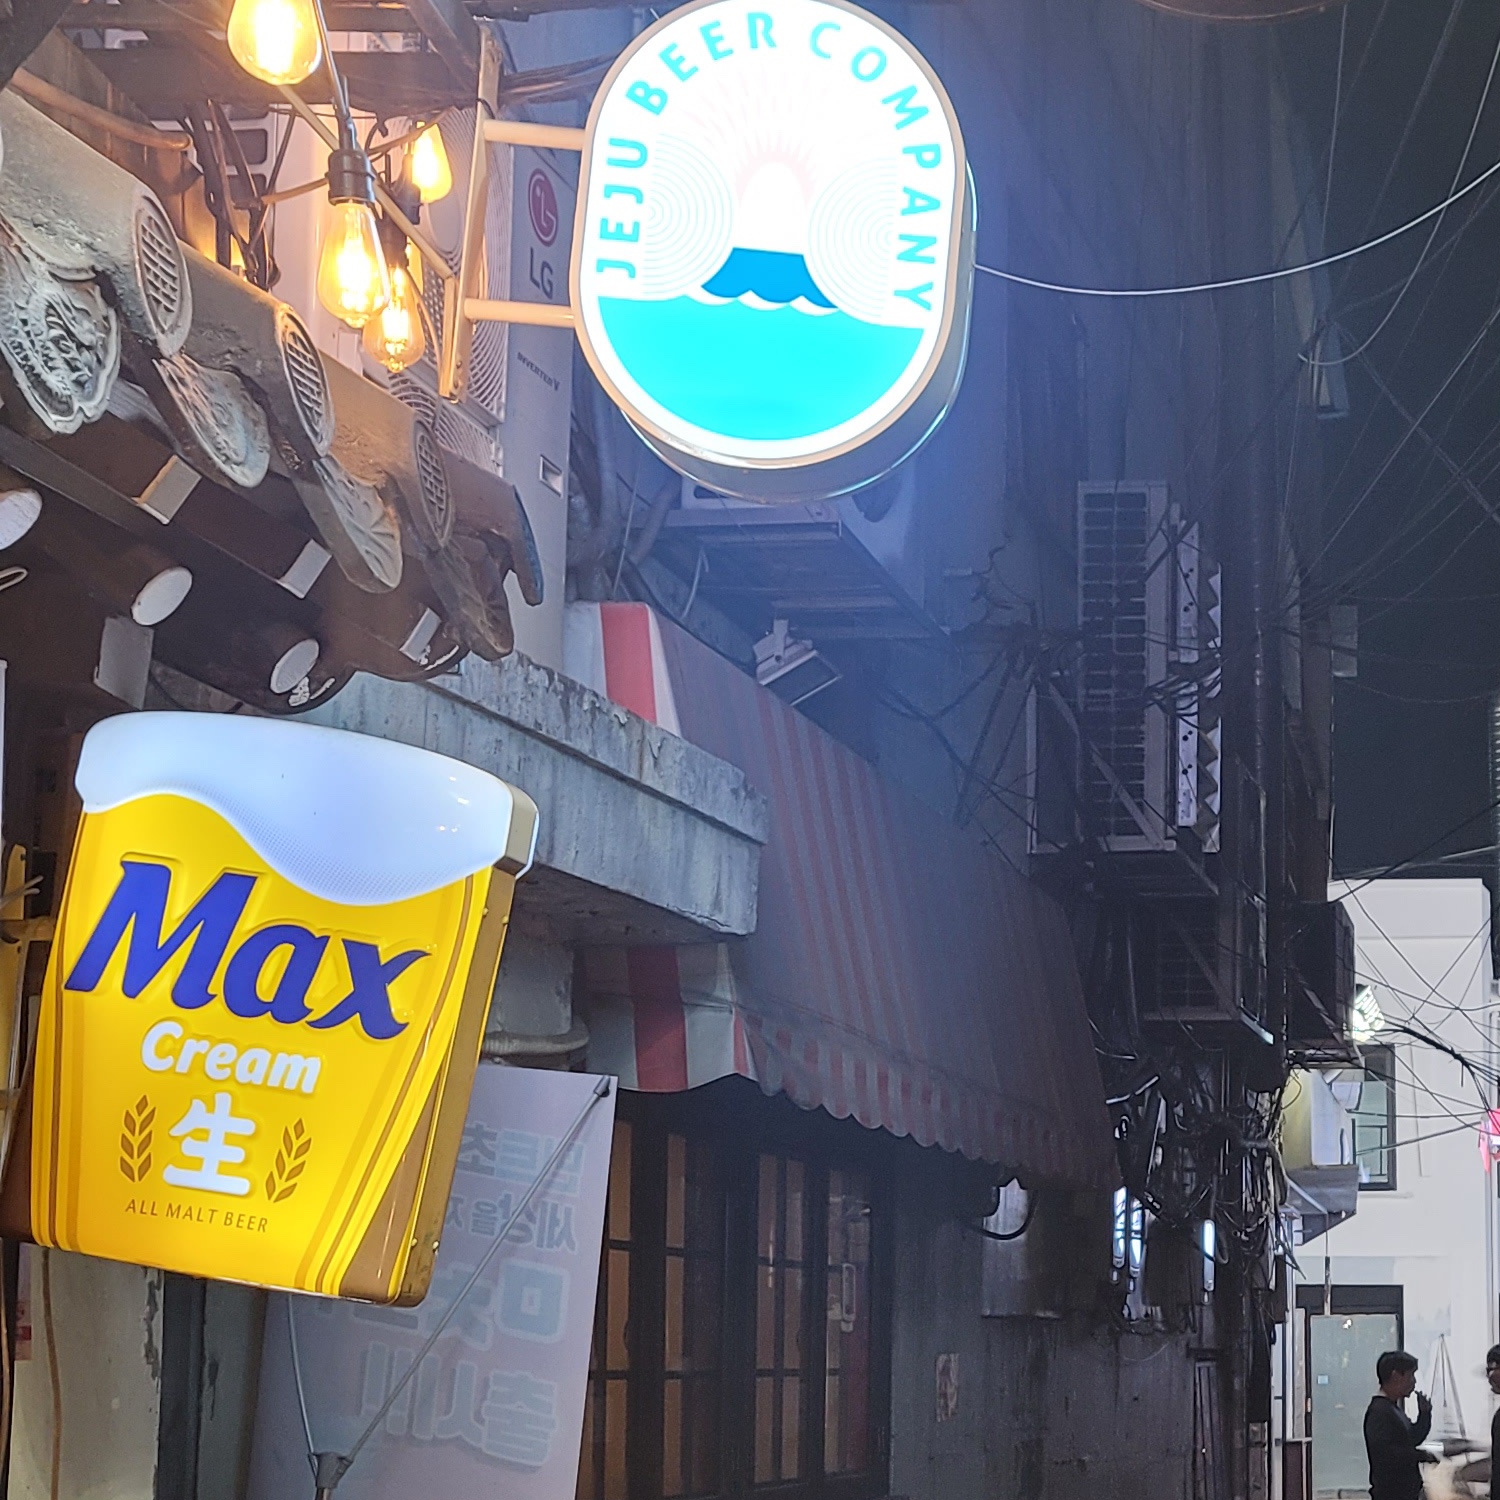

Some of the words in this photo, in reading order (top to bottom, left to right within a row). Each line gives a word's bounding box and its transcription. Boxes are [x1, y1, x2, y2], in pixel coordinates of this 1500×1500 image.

[596, 138, 648, 278] JEJU
[625, 12, 777, 115] BEER
[809, 21, 941, 311] COMPANY
[529, 246, 554, 301] LG
[64, 861, 432, 1040] Max
[141, 1020, 322, 1094] Cream
[162, 1091, 256, 1196] 生
[125, 1199, 158, 1216] ALL
[165, 1202, 218, 1224] MALT
[223, 1211, 268, 1233] BEER
